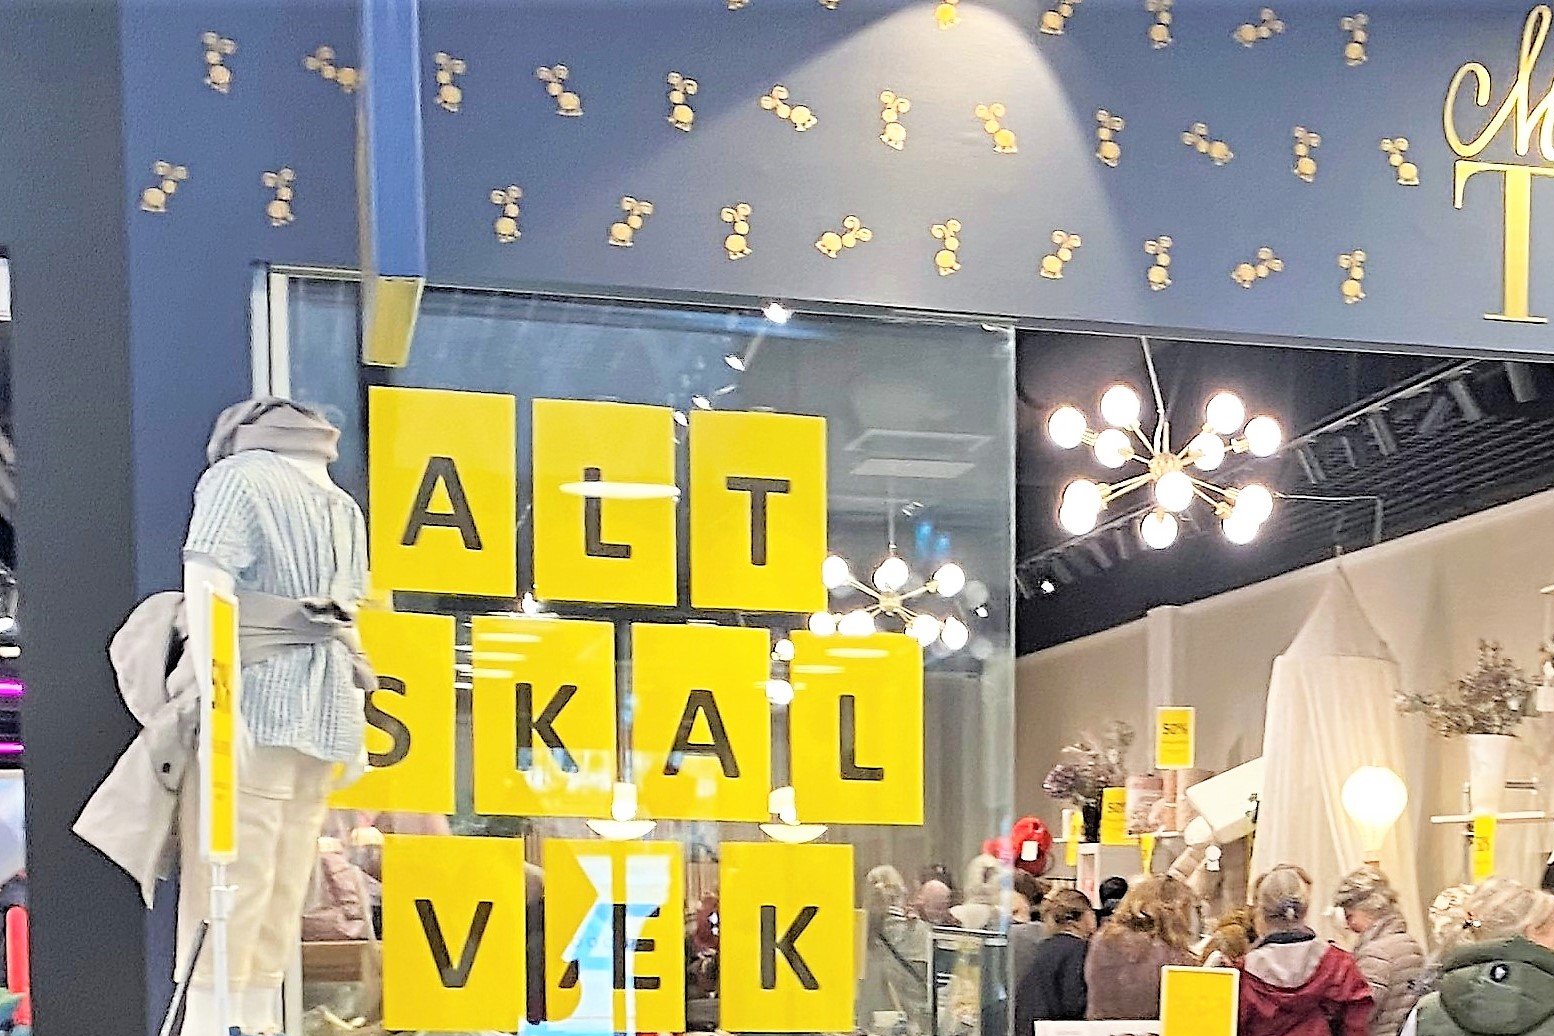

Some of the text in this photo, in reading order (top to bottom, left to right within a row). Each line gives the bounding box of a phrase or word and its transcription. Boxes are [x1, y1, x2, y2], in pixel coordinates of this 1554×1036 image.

[400, 456, 791, 566] ALT
[364, 675, 884, 781] SKAL
[415, 898, 821, 991] VÆK
